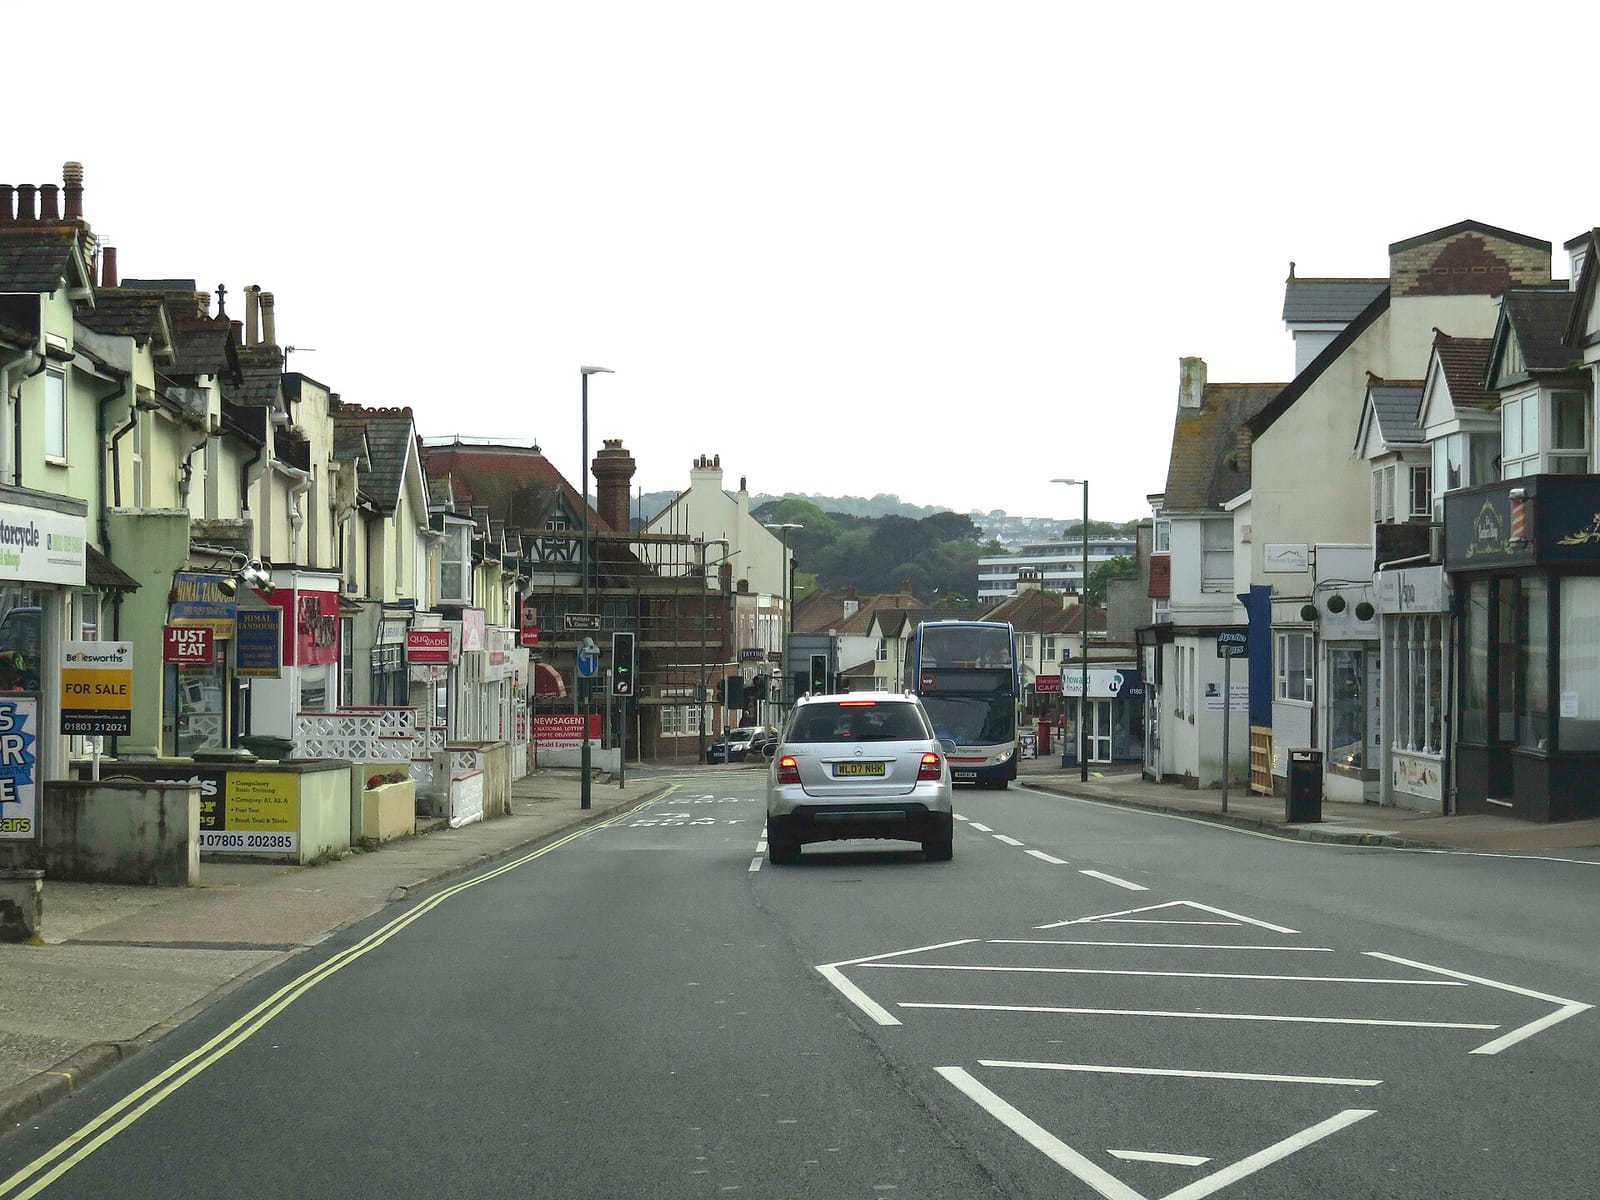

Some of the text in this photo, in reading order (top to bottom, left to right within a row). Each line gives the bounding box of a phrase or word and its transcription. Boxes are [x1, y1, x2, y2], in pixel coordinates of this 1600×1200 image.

[169, 630, 206, 643] JUST
[425, 638, 448, 646] VADIS
[178, 643, 206, 656] EAT
[1066, 674, 1091, 684] howad
[65, 683, 127, 695] FOR SALE
[64, 722, 127, 732] 01803 212021
[865, 763, 884, 774] NHK
[207, 834, 292, 848] 07805 202385
